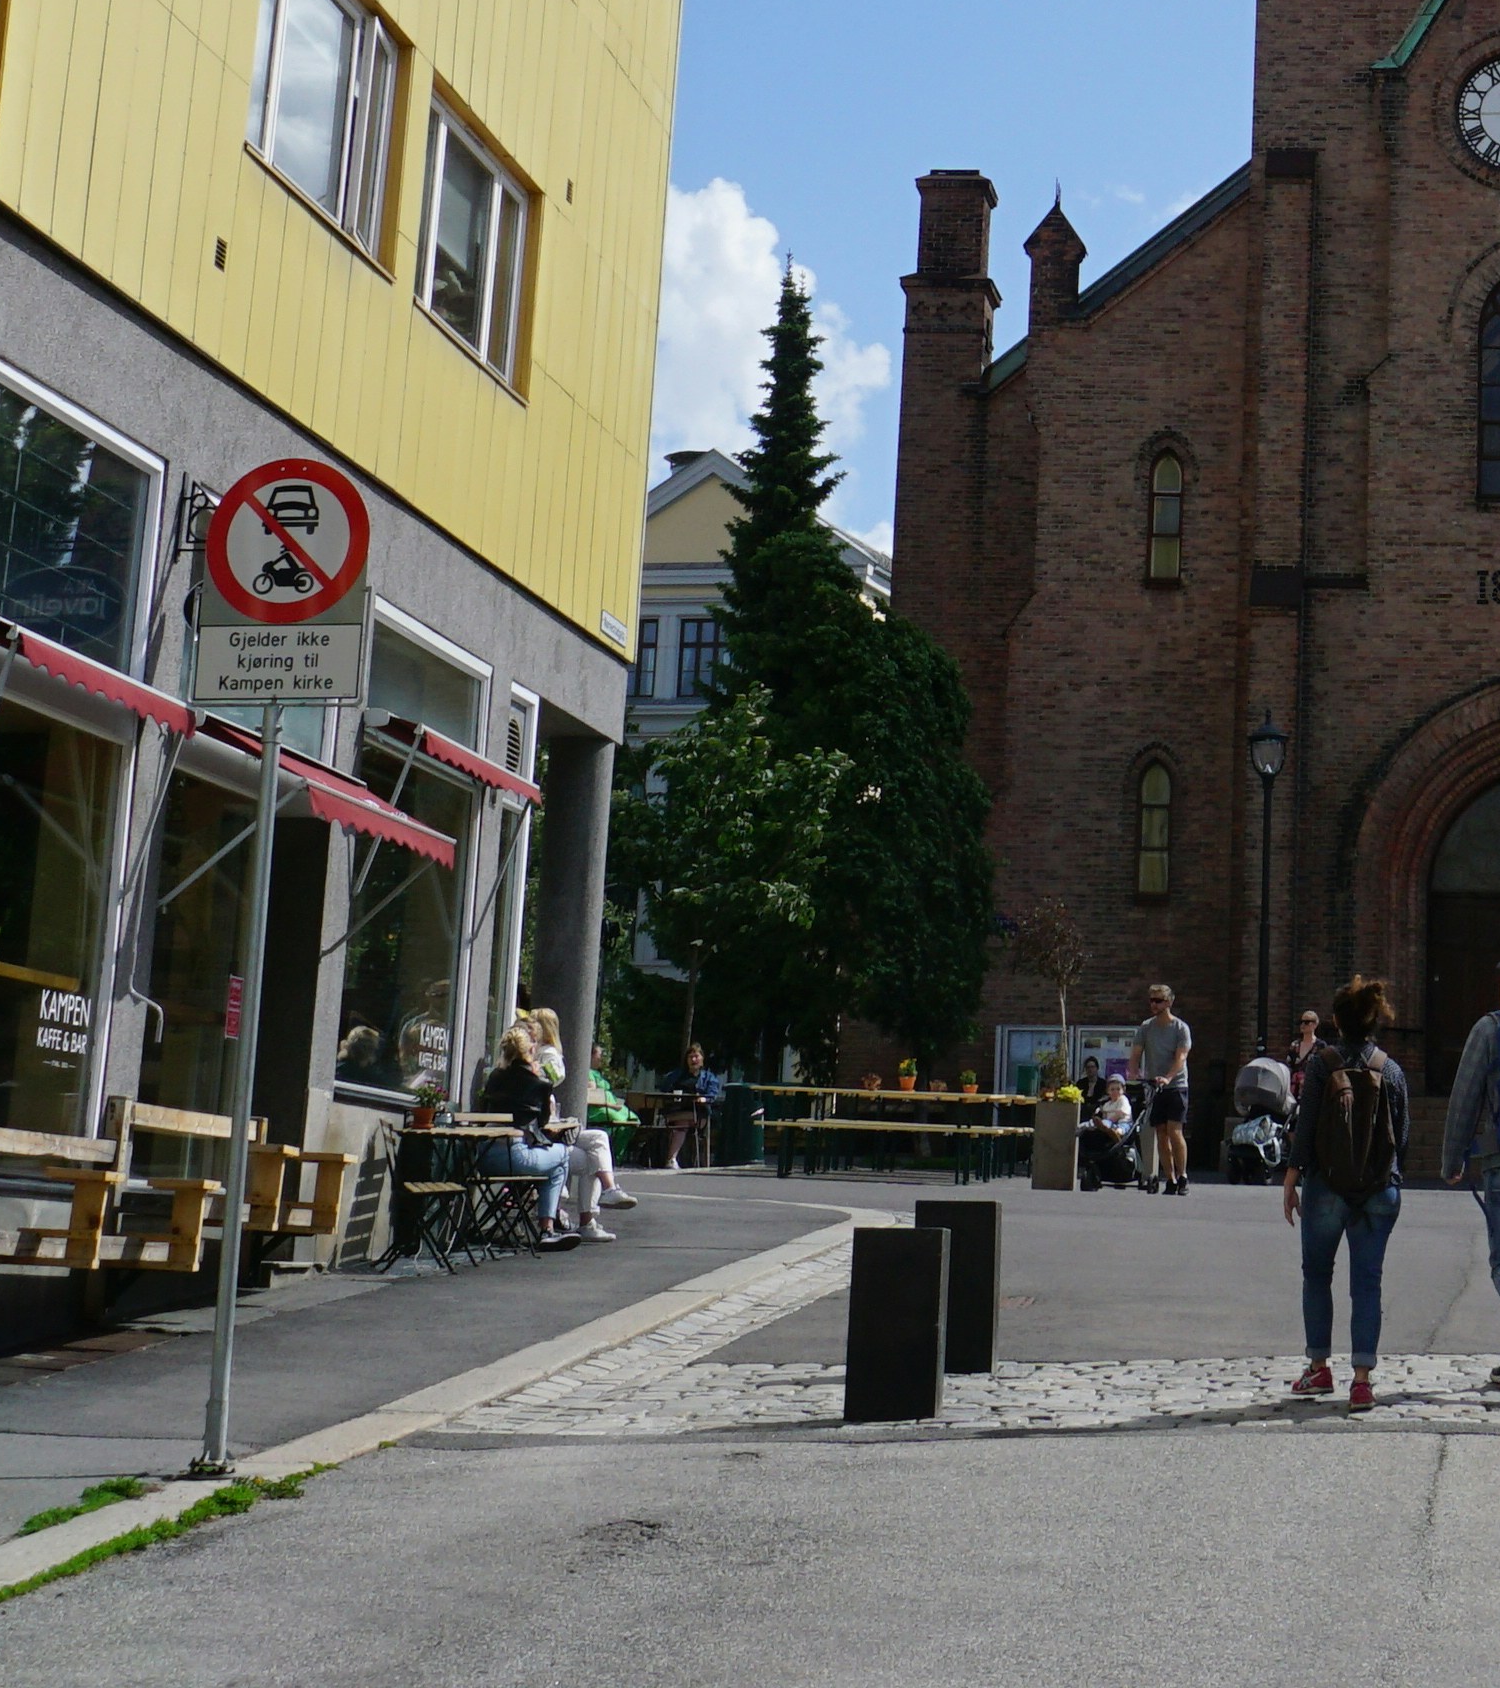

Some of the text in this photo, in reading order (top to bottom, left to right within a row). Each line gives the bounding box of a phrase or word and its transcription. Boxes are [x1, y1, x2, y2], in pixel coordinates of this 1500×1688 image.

[229, 632, 330, 650] Gjelder ikke
[237, 653, 319, 672] kjøring til
[218, 675, 333, 693] Kampen kirke
[40, 989, 92, 1027] KAMPEN
[36, 1026, 88, 1055] KAFFE & BAR
[419, 1023, 450, 1051] KAMPEN
